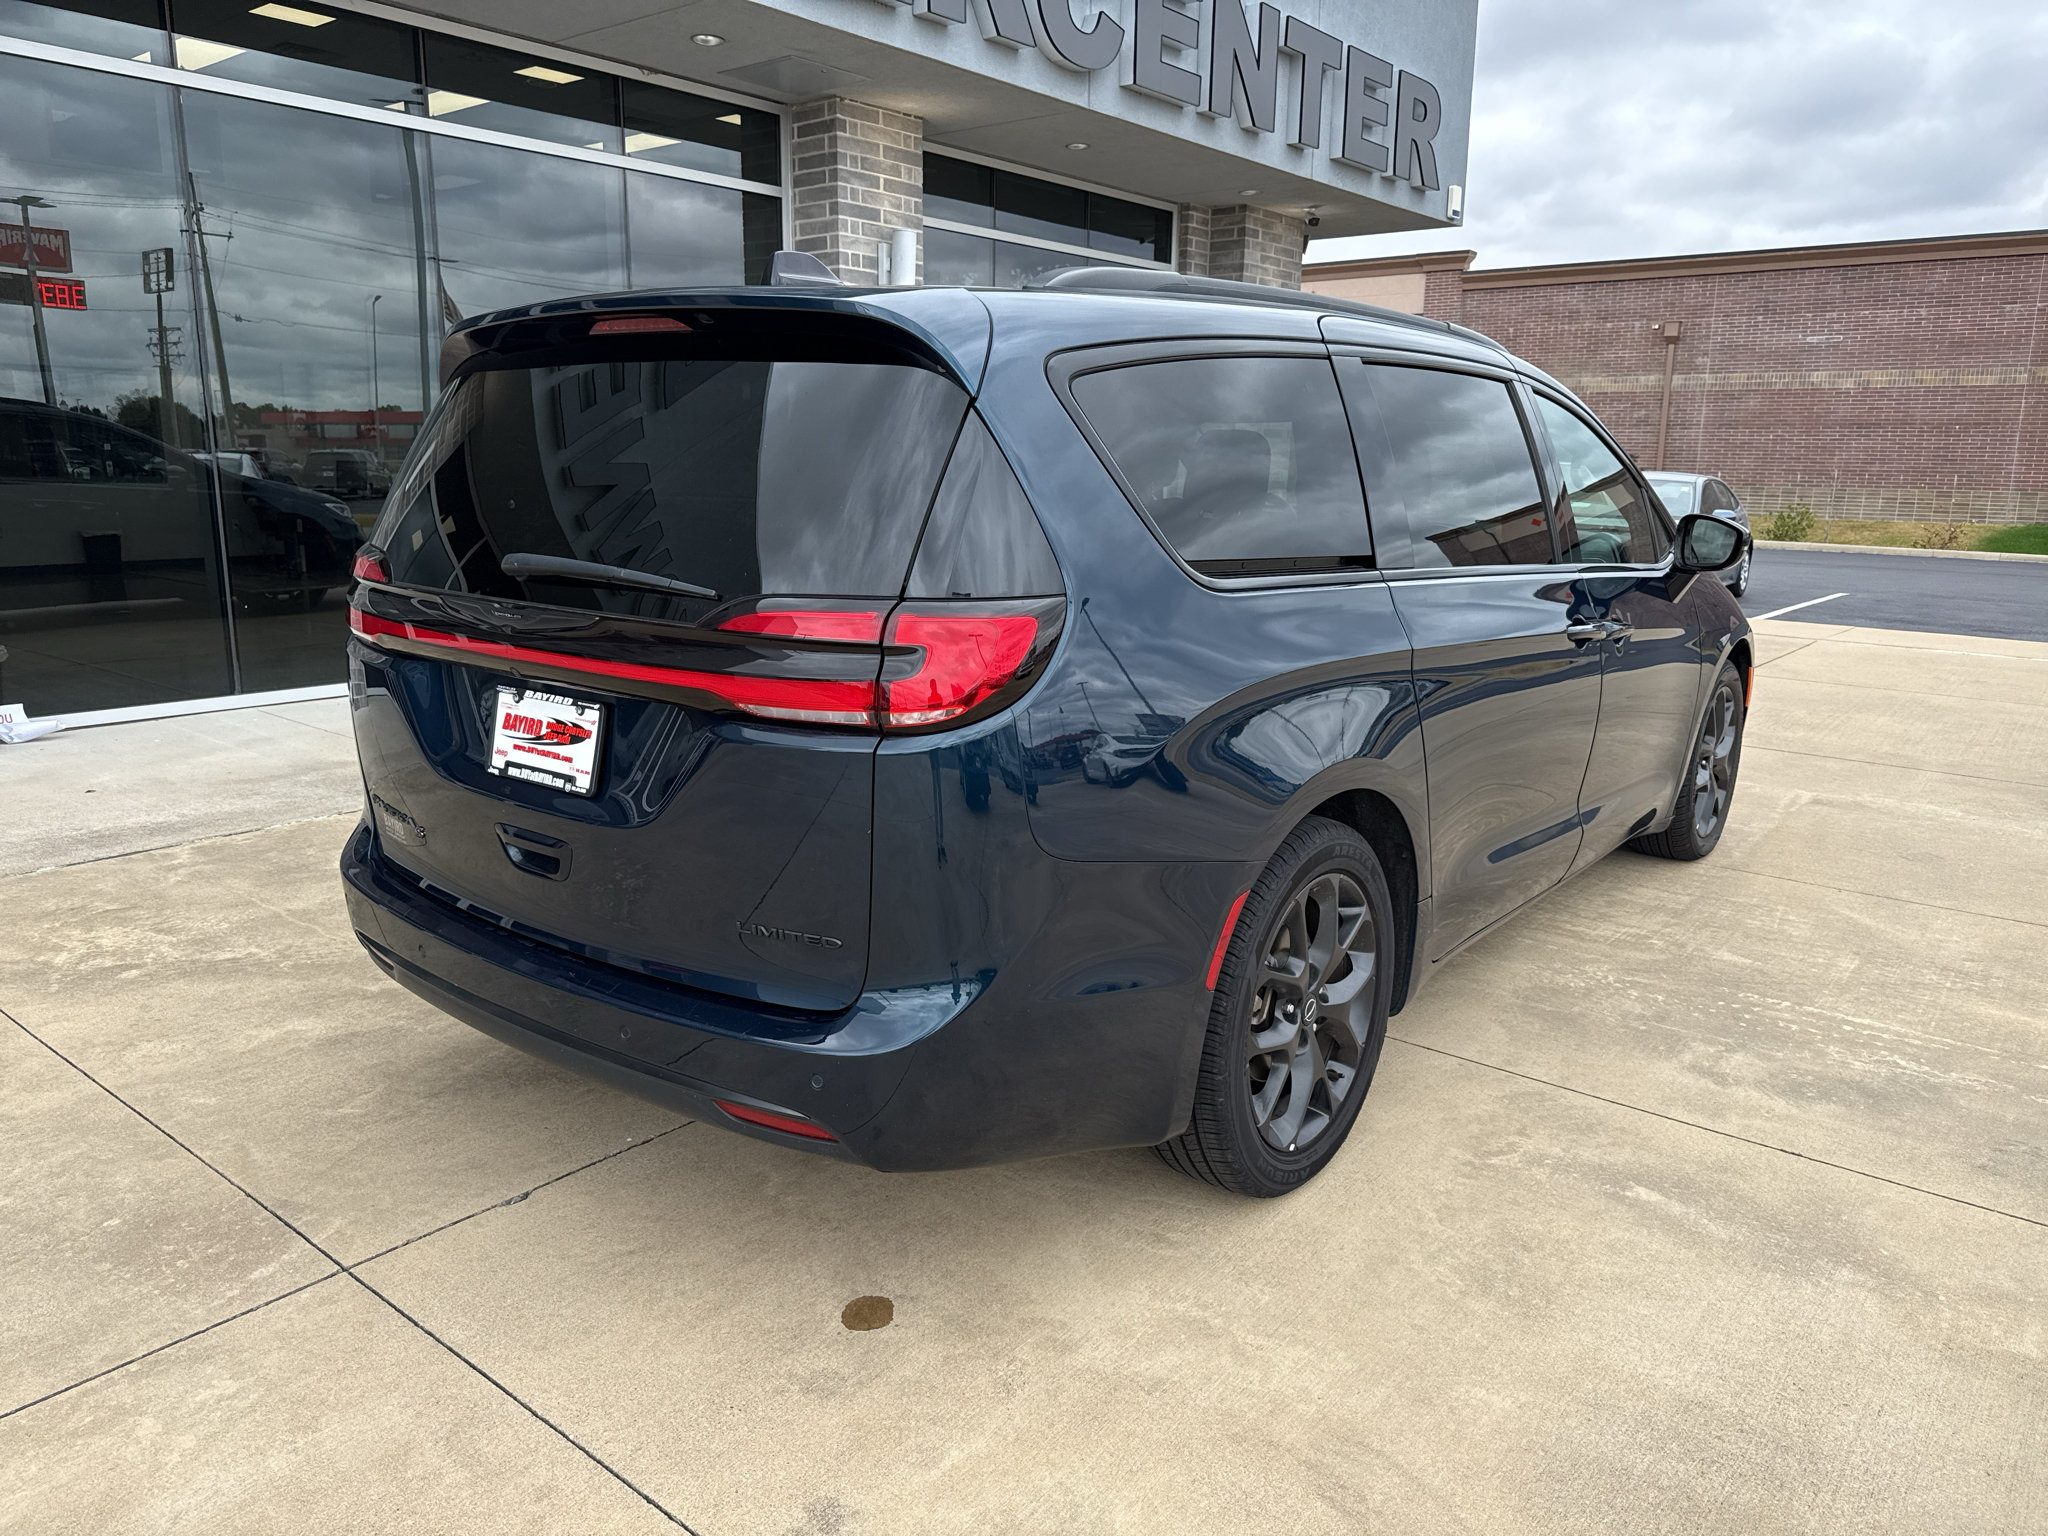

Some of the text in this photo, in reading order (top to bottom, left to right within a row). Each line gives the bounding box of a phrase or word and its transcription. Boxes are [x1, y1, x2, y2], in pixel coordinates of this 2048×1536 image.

[524, 690, 573, 706] BAYIRD
[502, 712, 543, 737] BAYIRD
[546, 721, 565, 734] DODGE
[565, 724, 592, 739] CHRYSLER
[494, 746, 508, 758] Jeep
[736, 920, 844, 949] LIMITED
[1257, 1158, 1310, 1182] ARISUN
